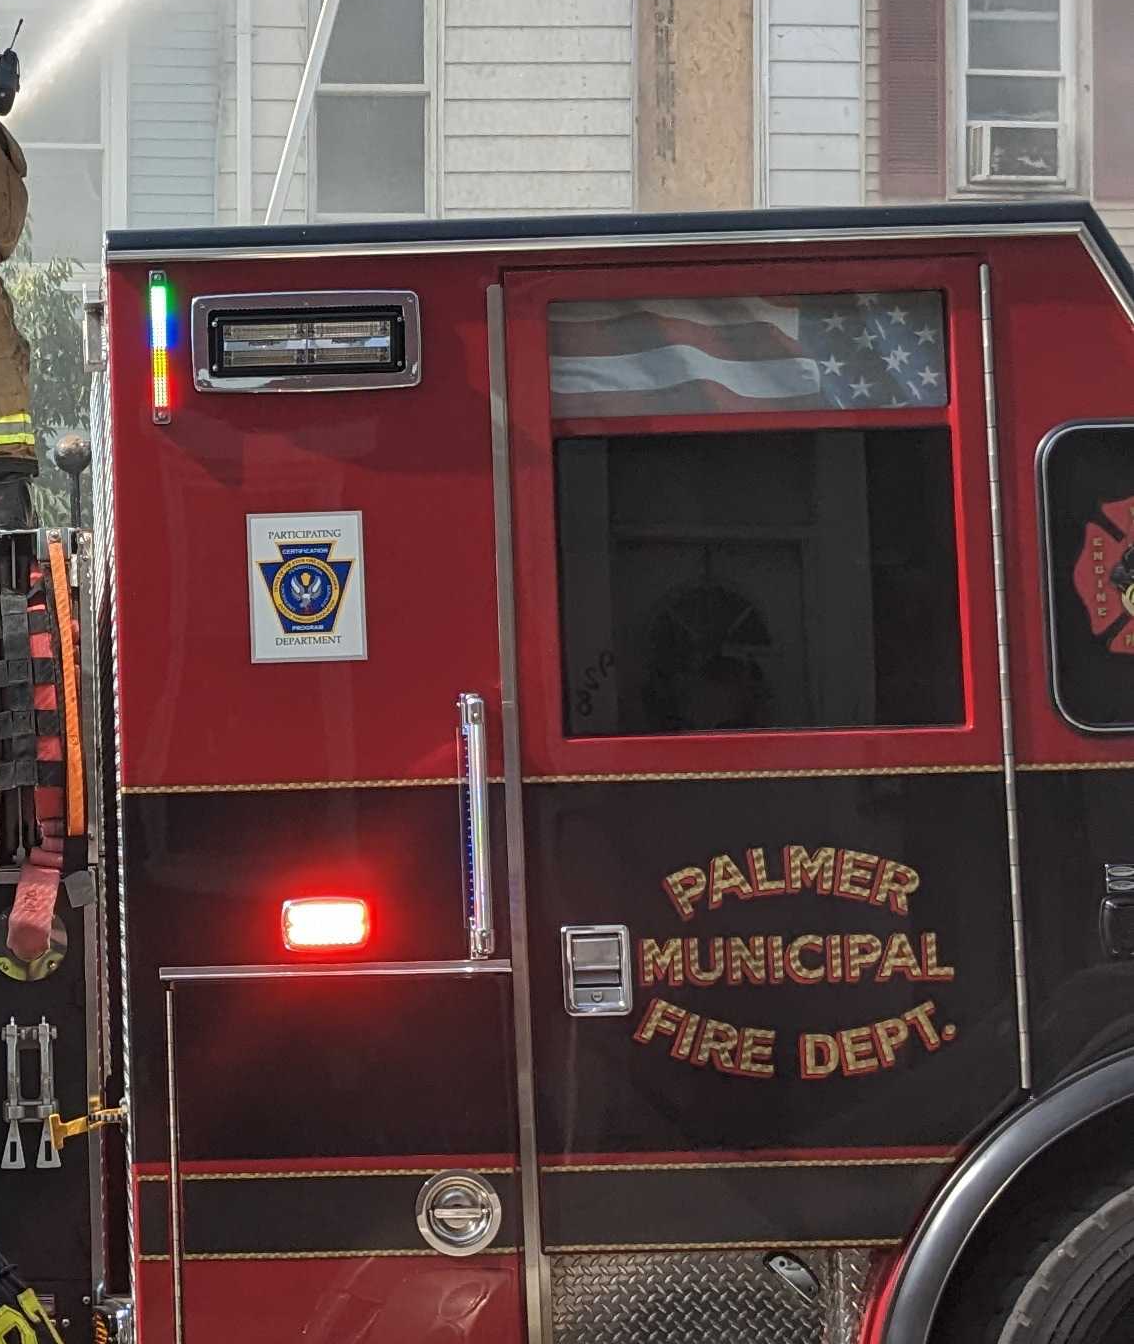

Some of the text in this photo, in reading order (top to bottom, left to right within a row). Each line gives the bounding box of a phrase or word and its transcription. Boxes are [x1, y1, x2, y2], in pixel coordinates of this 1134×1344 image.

[267, 528, 342, 540] PARTICIPATING
[281, 547, 329, 555] CERTIFICATION
[1092, 537, 1107, 617] ENGINE
[274, 635, 342, 647] DEPARTMENT
[661, 844, 921, 922] PALMER
[637, 931, 955, 988] MUNICIPAL
[632, 998, 958, 1080] FIRE DEPT.
